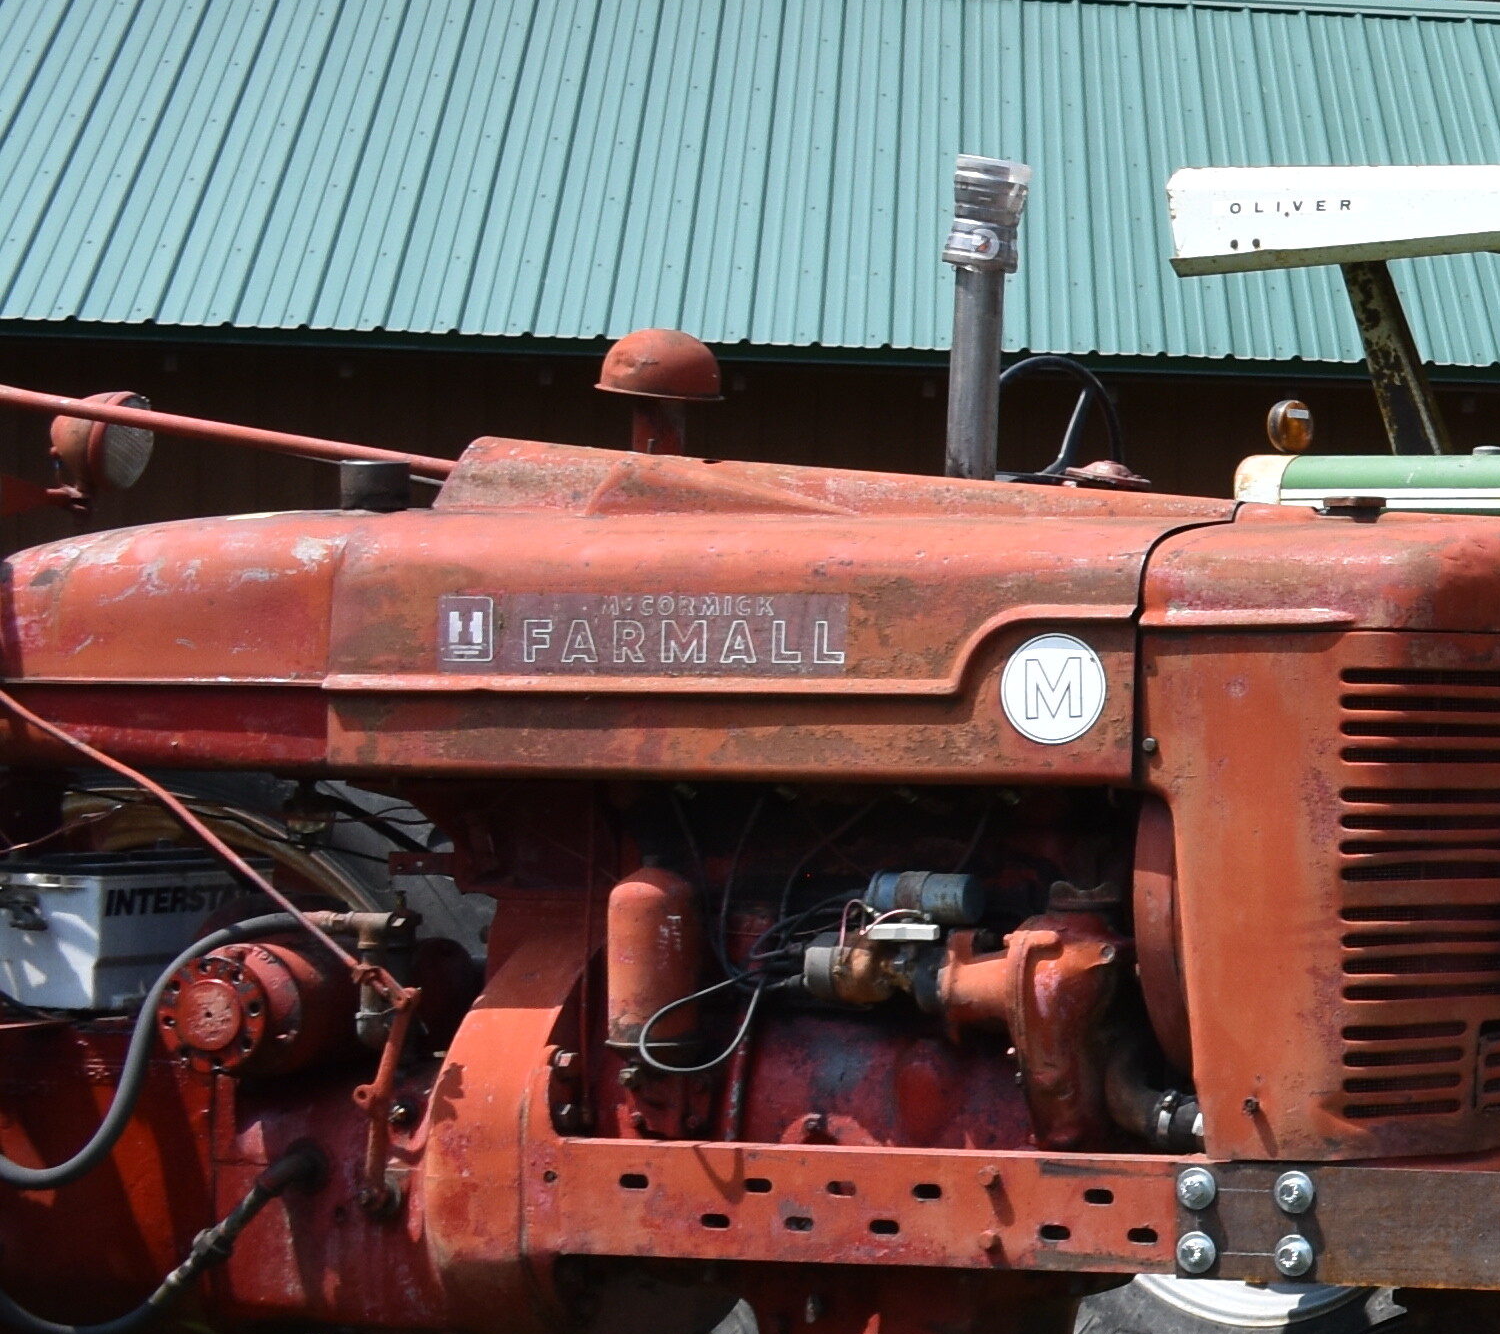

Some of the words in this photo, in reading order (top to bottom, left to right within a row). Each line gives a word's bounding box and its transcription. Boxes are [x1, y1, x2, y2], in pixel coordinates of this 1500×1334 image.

[1229, 199, 1351, 214] OLIVER
[522, 619, 846, 664] FARMALL
[1025, 657, 1082, 720] M
